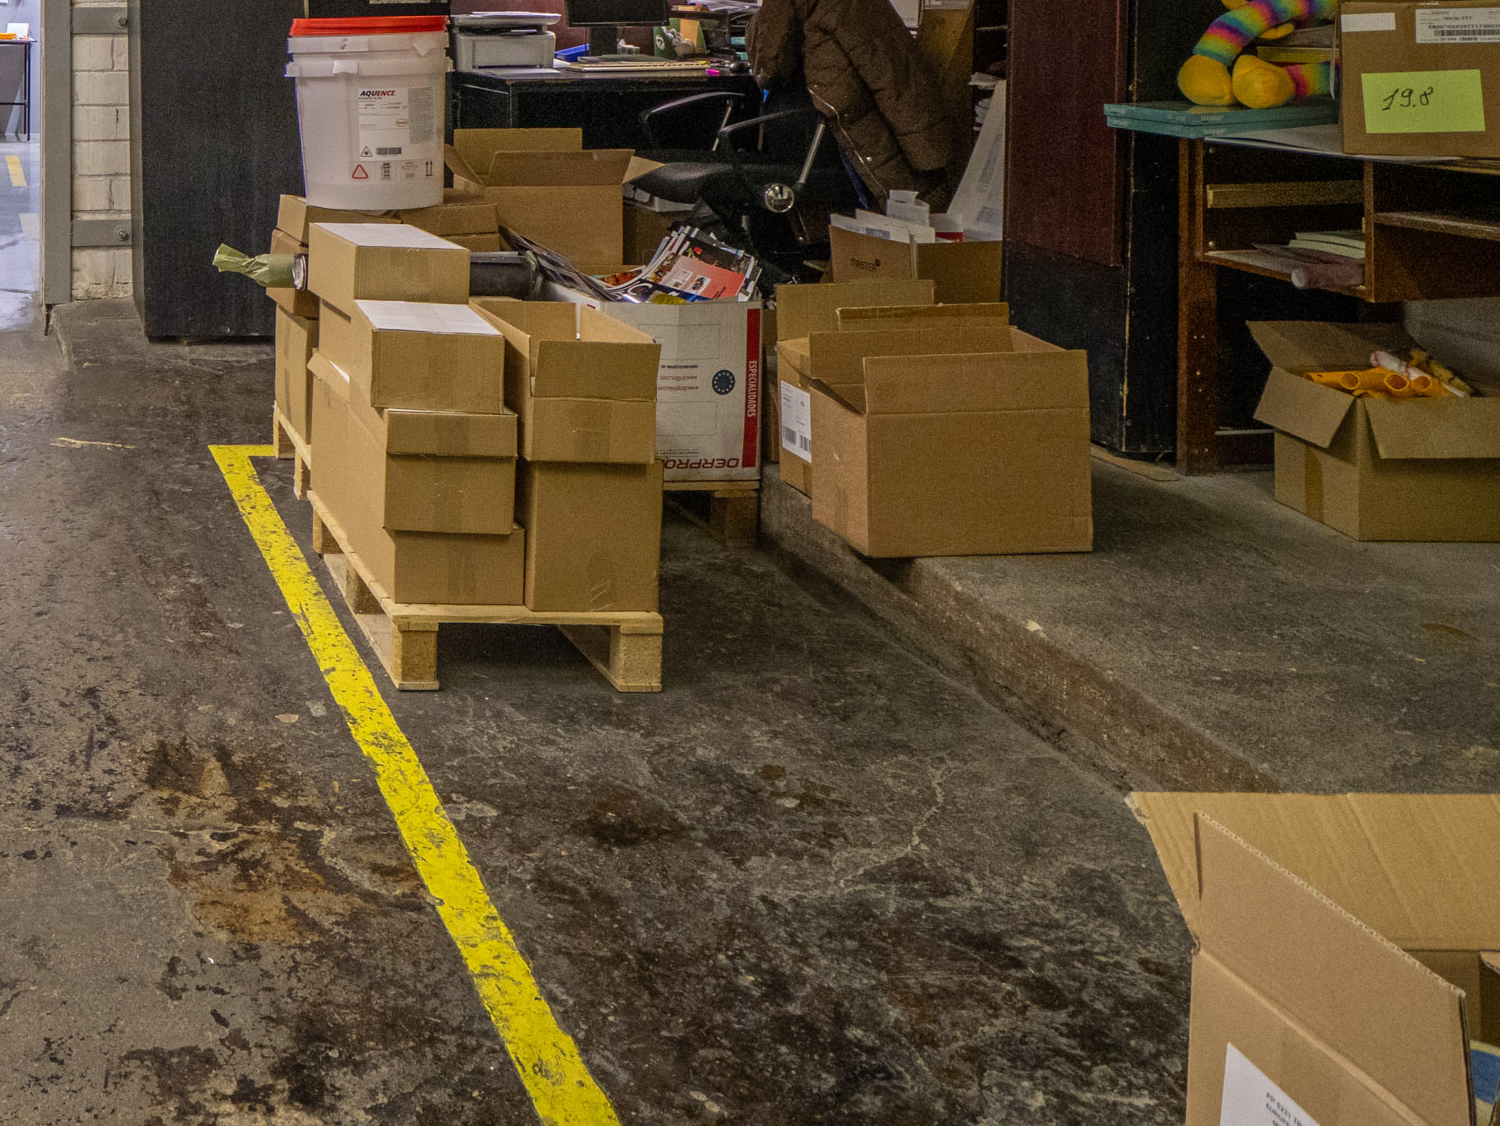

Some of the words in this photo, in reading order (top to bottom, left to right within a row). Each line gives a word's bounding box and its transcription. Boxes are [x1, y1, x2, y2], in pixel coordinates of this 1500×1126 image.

[1382, 86, 1434, 111] 19.8
[748, 360, 757, 418] ESPECIALIDADES
[660, 458, 740, 470] DERPRO
